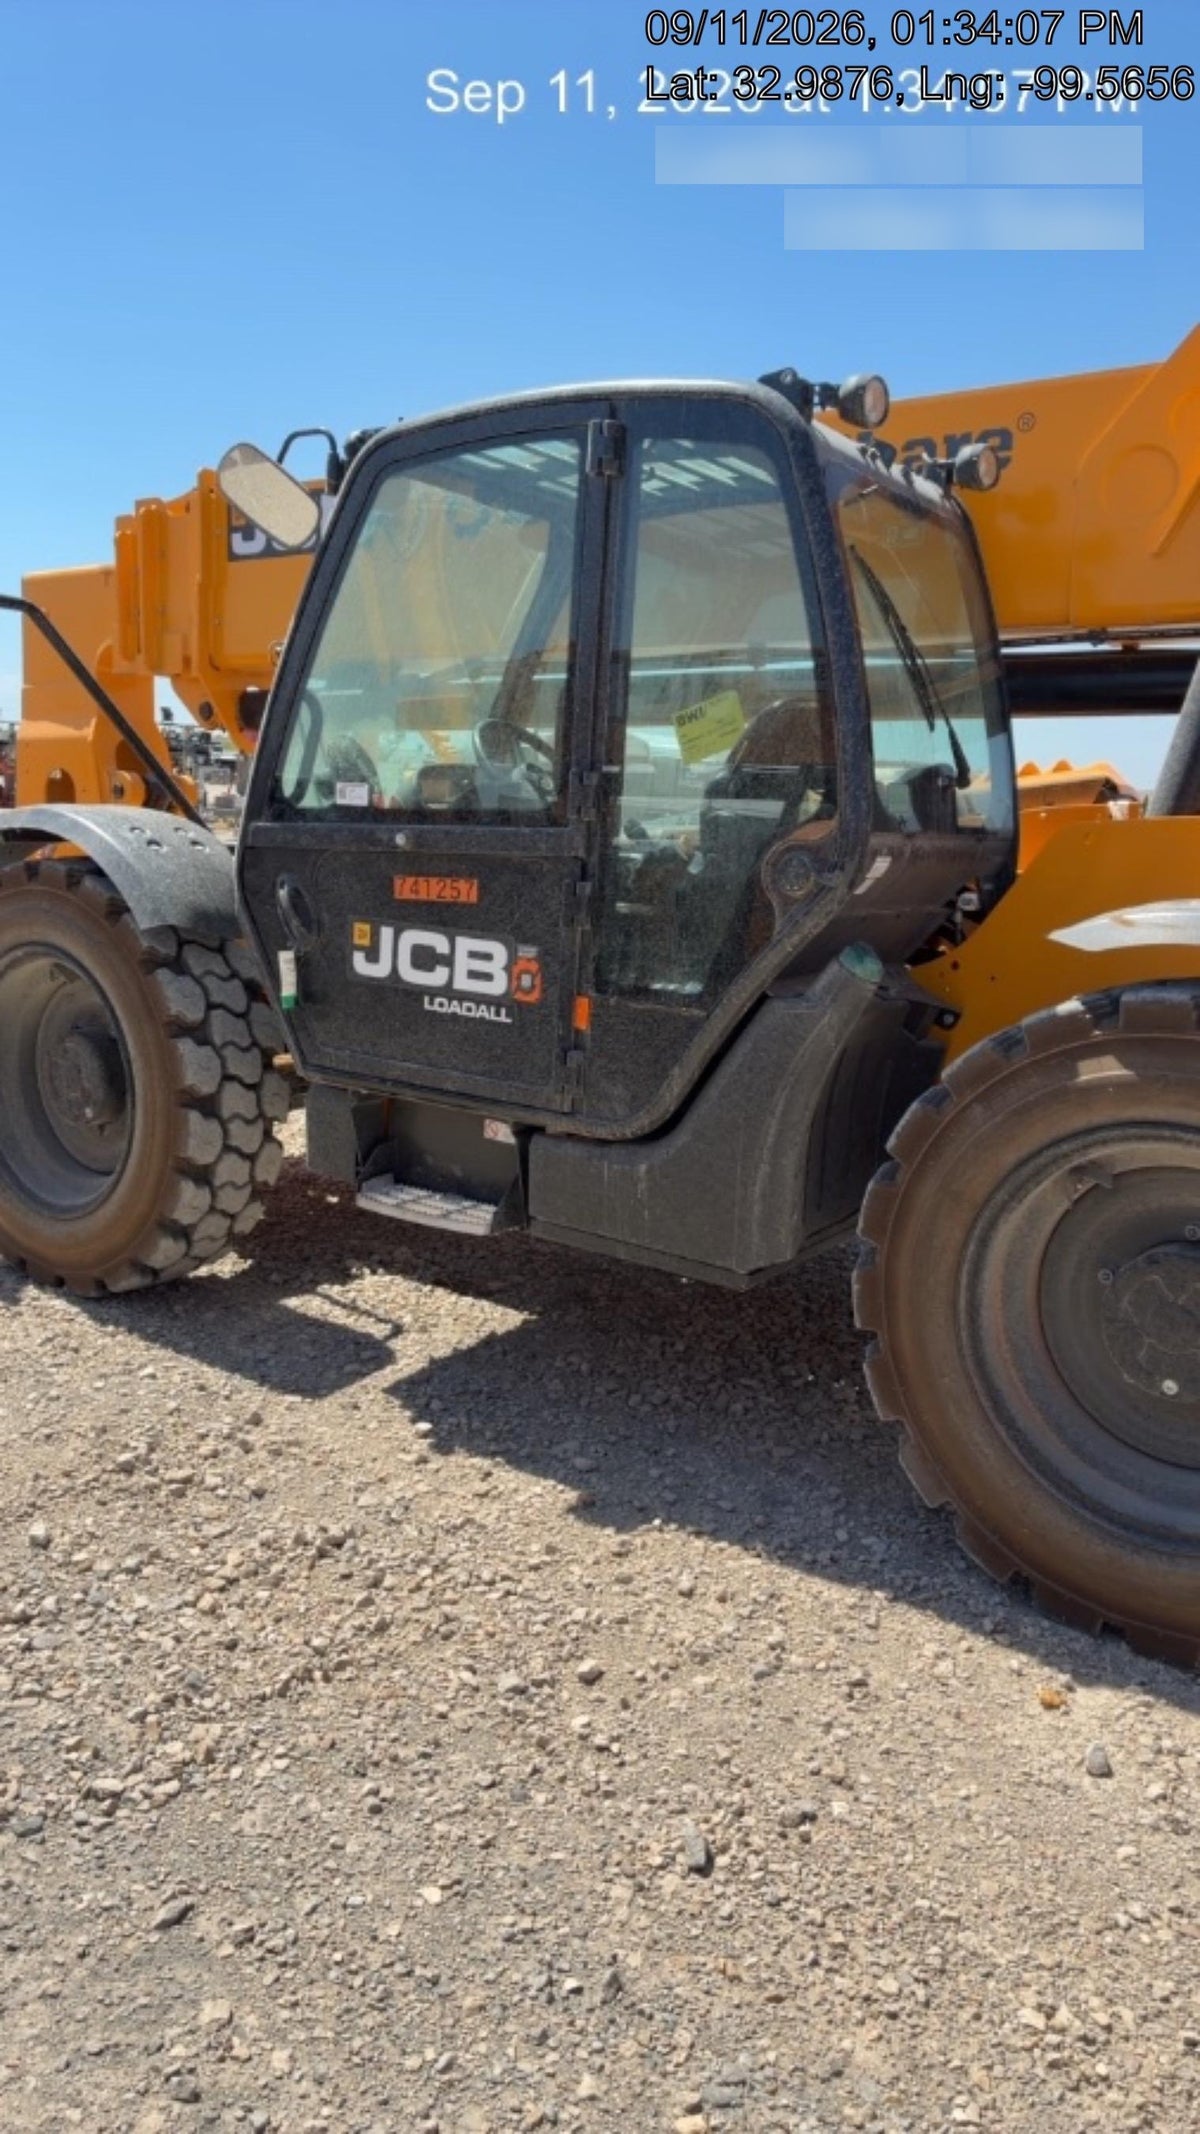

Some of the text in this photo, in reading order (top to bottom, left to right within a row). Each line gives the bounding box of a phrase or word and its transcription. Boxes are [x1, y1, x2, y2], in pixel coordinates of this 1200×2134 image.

[398, 876, 474, 901] 741257
[352, 926, 508, 996] JCB
[423, 995, 513, 1023] LOADALL
